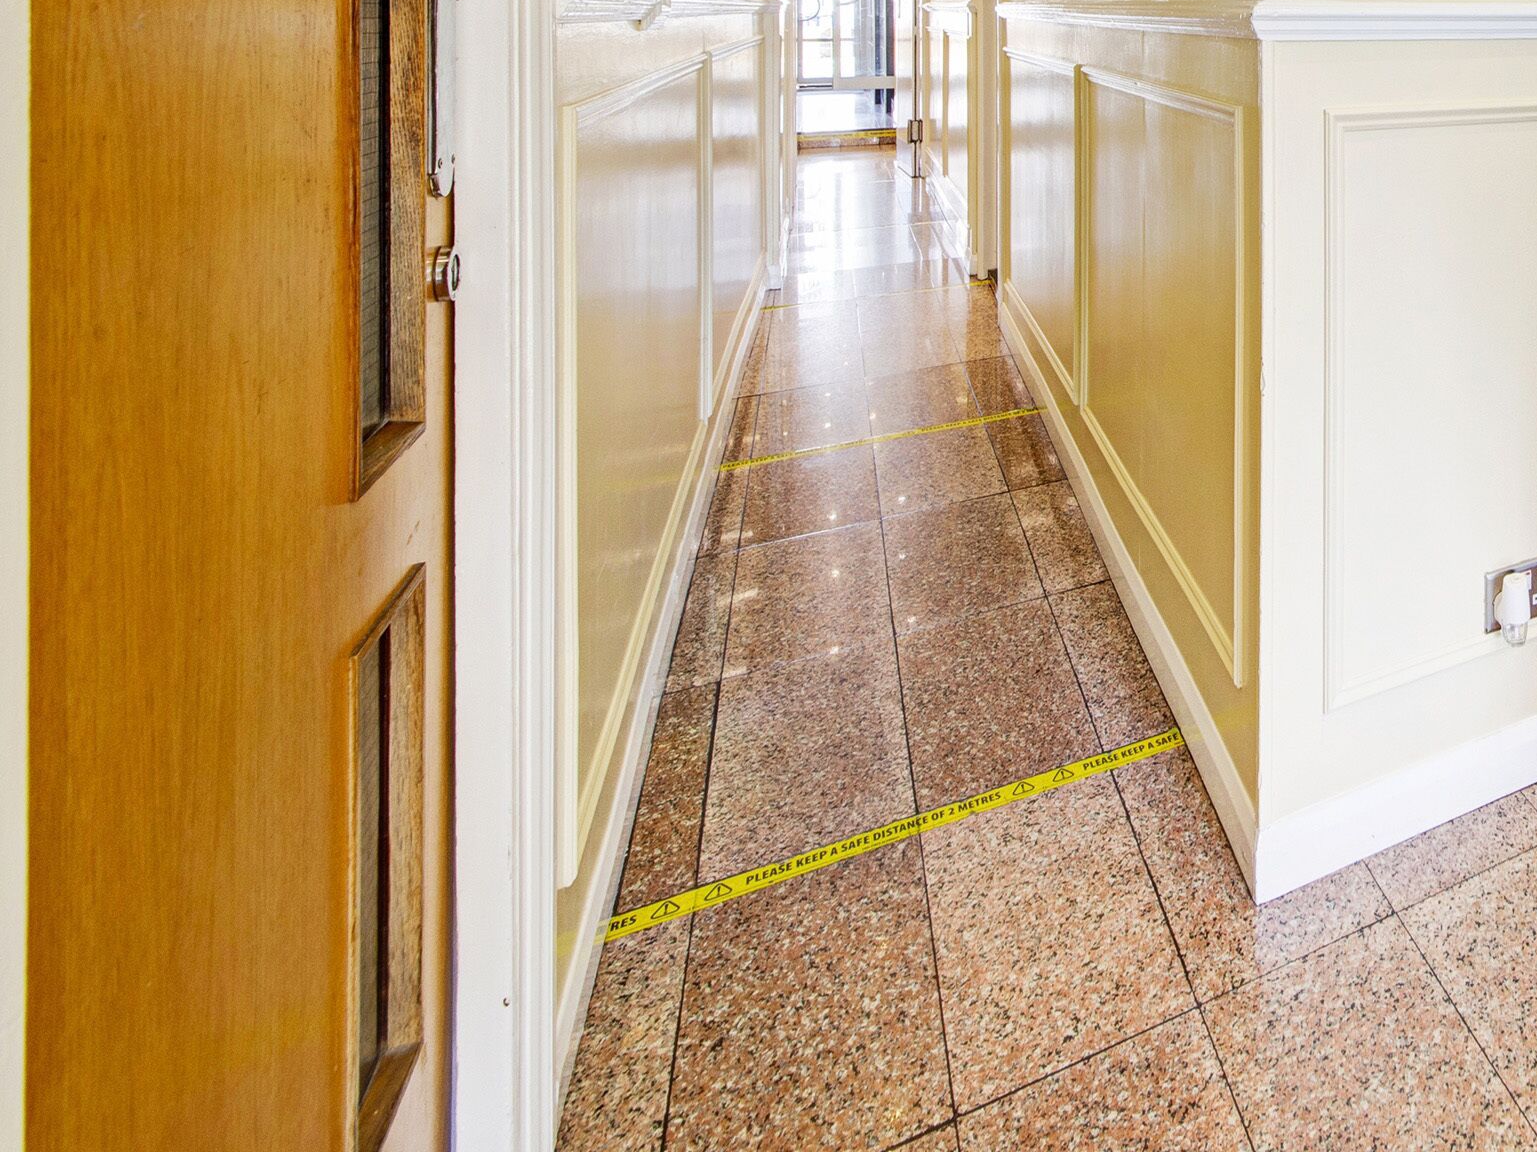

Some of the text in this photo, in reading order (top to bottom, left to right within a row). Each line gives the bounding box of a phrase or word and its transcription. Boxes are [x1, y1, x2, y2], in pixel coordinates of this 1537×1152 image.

[745, 862, 793, 885] PLEASE
[796, 850, 827, 868] KEEP
[830, 847, 838, 856] A
[841, 836, 870, 853] SAFE
[873, 815, 929, 841] DISTANCE
[931, 809, 945, 821] OF
[948, 807, 955, 815] 2
[958, 791, 1001, 812] METRES
[1083, 753, 1119, 771] PLEASE
[1121, 744, 1145, 759] KEEP
[1147, 741, 1154, 749] A
[1155, 732, 1179, 747] SAFE
